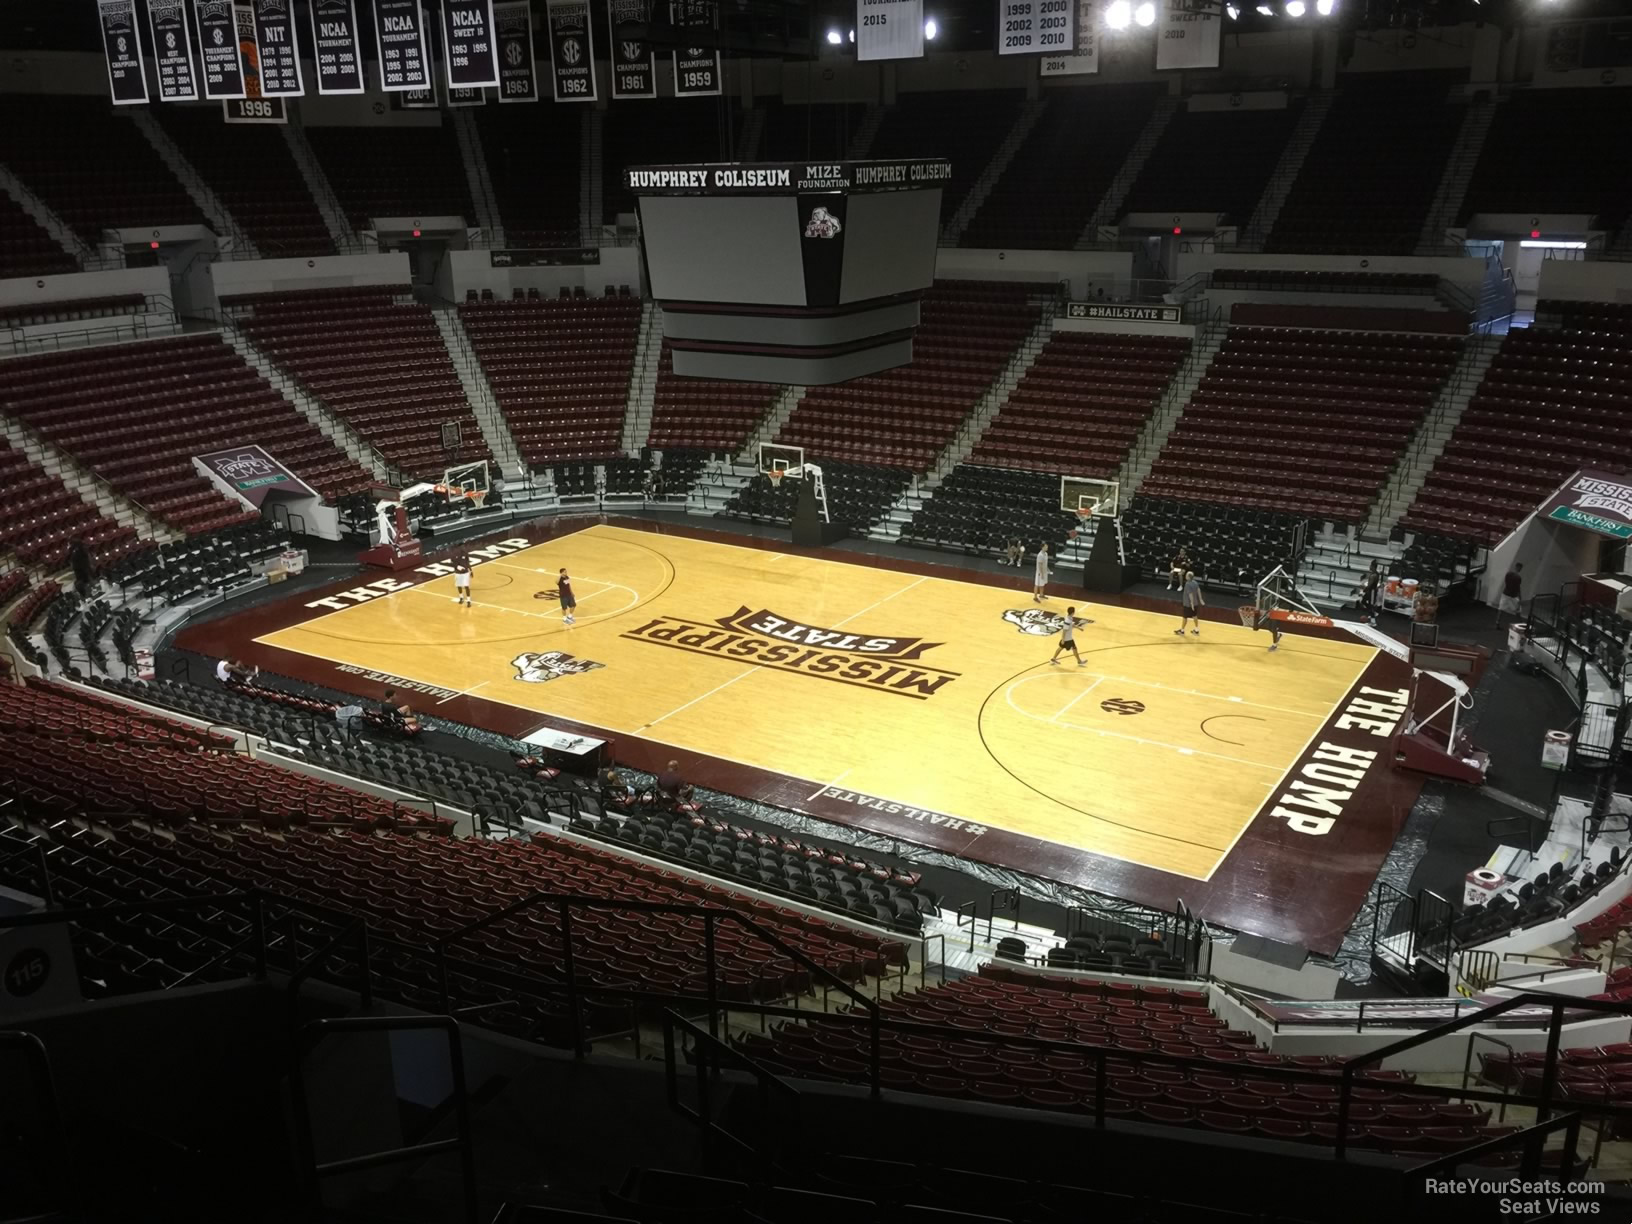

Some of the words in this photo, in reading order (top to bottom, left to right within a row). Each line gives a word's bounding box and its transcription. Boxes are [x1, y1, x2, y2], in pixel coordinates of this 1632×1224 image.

[1007, 3, 1031, 16] 1999
[1040, 1, 1067, 13] 2000
[383, 15, 414, 32] NCAA
[451, 9, 484, 27] NCAA
[863, 14, 887, 26] 2015
[1006, 19, 1032, 32] 2002
[1039, 17, 1066, 29] 2003
[1170, 14, 1198, 22] SWEET
[264, 26, 285, 42] NIT
[320, 22, 348, 37] NCAA
[453, 28, 475, 37] SWEET
[477, 27, 484, 36] 16
[1164, 30, 1185, 39] 2010
[318, 39, 352, 47] TOURNAMENT
[382, 32, 418, 42] TOURNAMENT
[1005, 35, 1031, 47] 2009
[1040, 33, 1065, 44] 2010
[385, 49, 400, 59] 1963
[405, 48, 418, 57] 1991
[451, 44, 468, 54] 1963
[472, 43, 488, 53] 1995
[563, 39, 580, 63] SEC
[320, 54, 336, 63] 2004
[386, 61, 402, 70] 1995
[405, 60, 420, 69] 1996
[453, 57, 469, 66] 1996
[679, 59, 714, 69] CHAMPIONS
[502, 68, 530, 77] CHAMPIONS
[558, 67, 588, 75] CHAMPIONS
[616, 63, 649, 72] CHAMPIONS
[1046, 61, 1066, 71] 2014
[387, 73, 403, 82] 2002
[406, 71, 422, 81] 2003
[621, 75, 644, 90] 1961
[684, 72, 711, 87] 1959
[505, 80, 529, 94] 1963
[562, 79, 587, 93] 1962
[407, 89, 430, 99] 2004
[238, 101, 273, 117] 1996
[629, 170, 708, 187] HUMPHREY
[714, 169, 791, 187] COLISEUM
[806, 165, 842, 179] MIZE
[855, 165, 907, 185] HUMPHREY
[910, 163, 952, 181] COLISEUM
[797, 179, 850, 189] FOUNDATION
[1089, 306, 1158, 319] #HAILSTATE
[226, 460, 261, 473] STATE
[1573, 478, 1632, 502] MISSIS
[304, 578, 414, 610] THE
[1296, 615, 1327, 624] StateFarm
[751, 615, 897, 651] STATE
[627, 619, 956, 695] MISSISSIPPI
[1334, 686, 1410, 737] THE
[1269, 741, 1378, 836] HUMP
[823, 788, 988, 835] #HAILSTATE
[11, 958, 43, 986] 115
